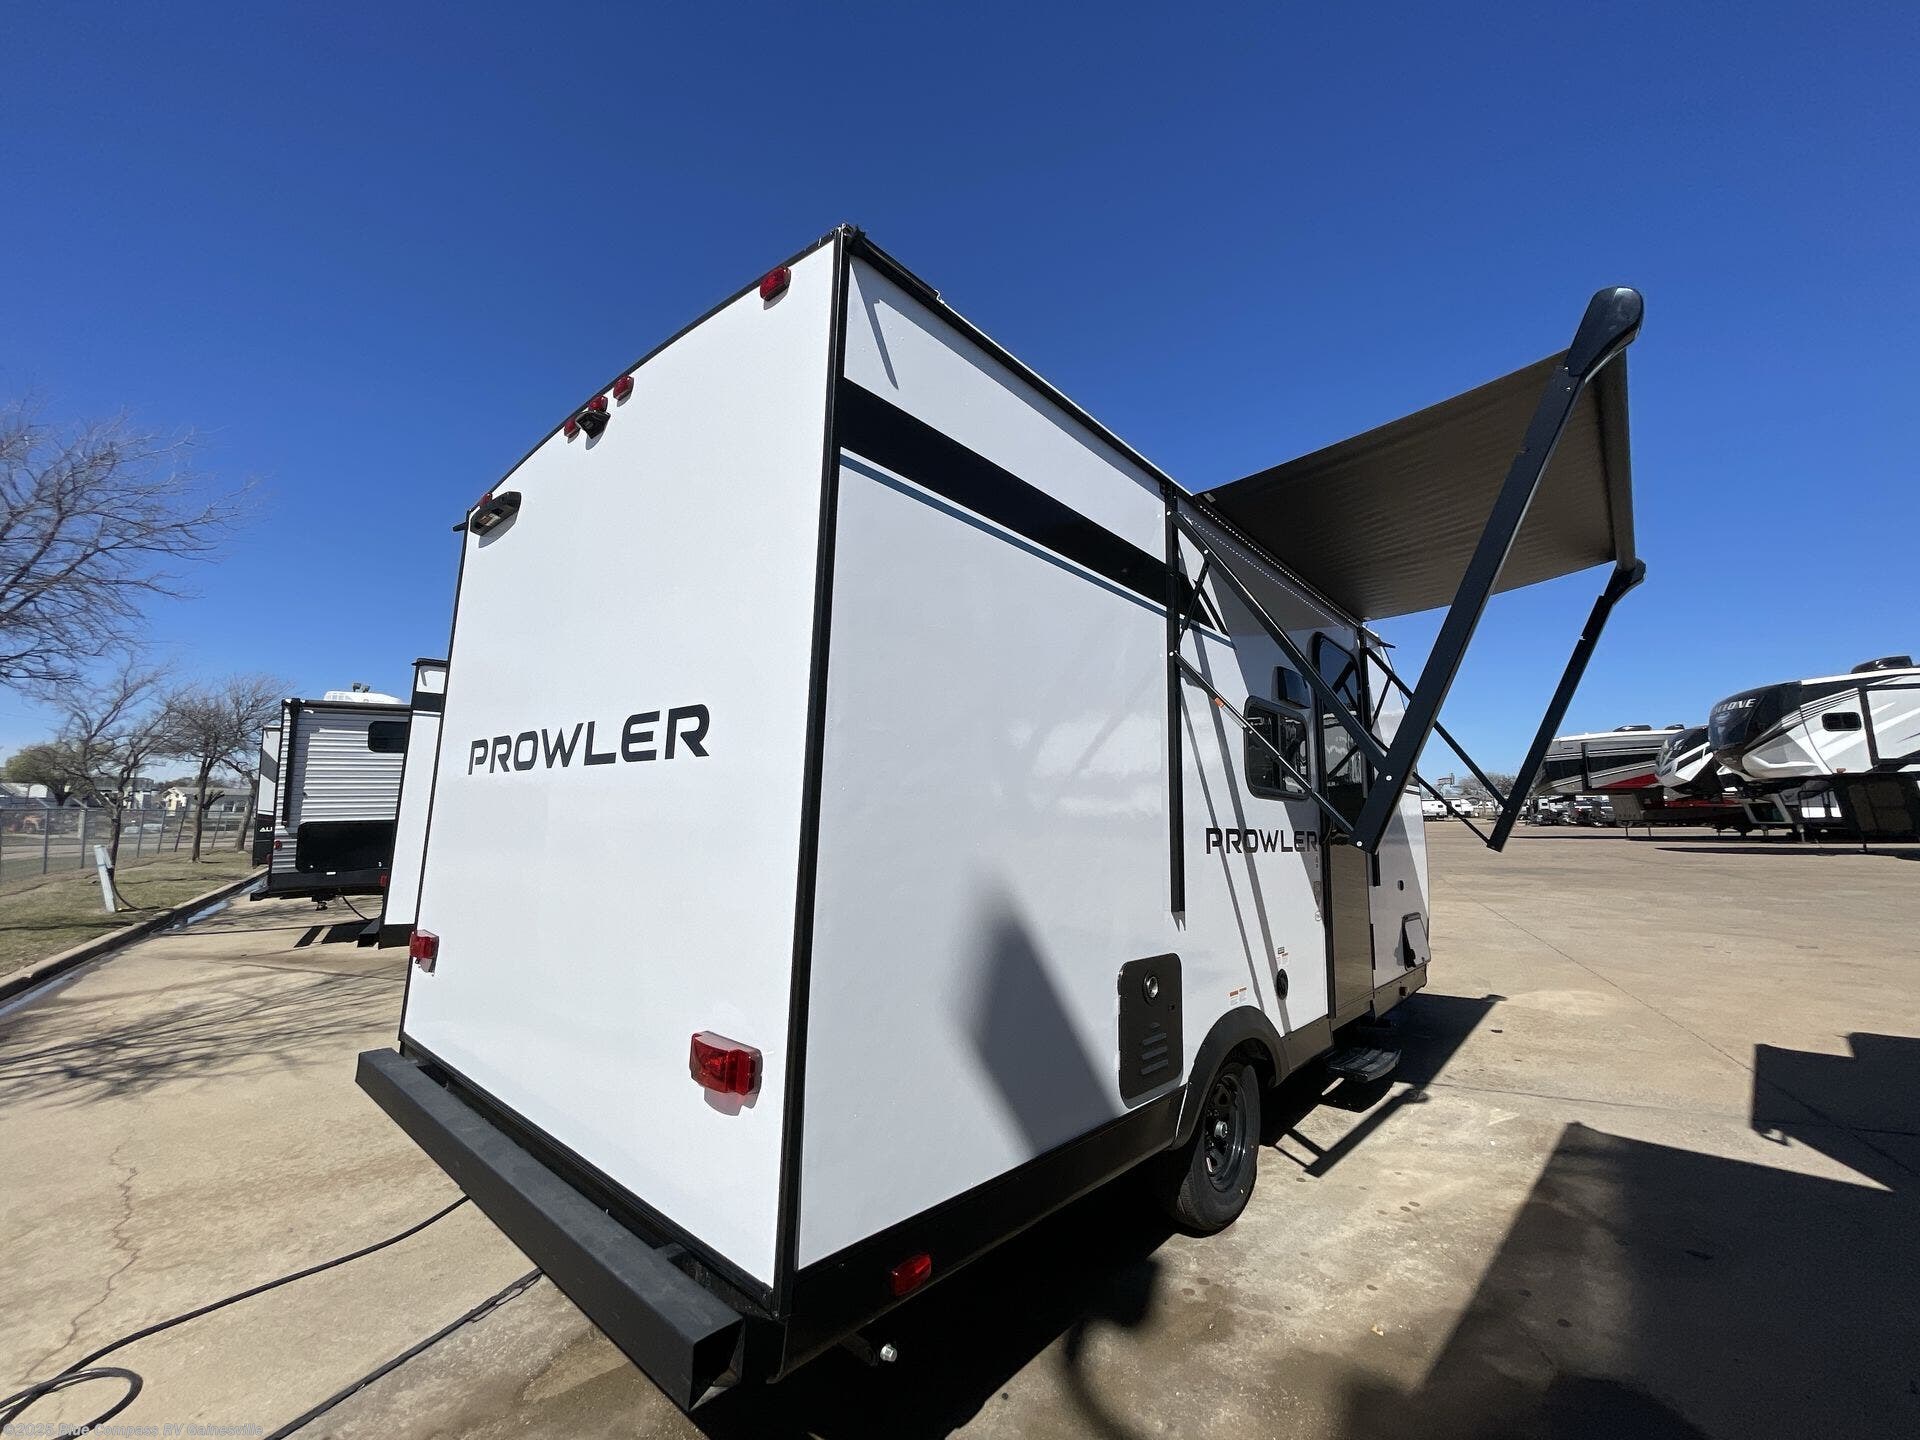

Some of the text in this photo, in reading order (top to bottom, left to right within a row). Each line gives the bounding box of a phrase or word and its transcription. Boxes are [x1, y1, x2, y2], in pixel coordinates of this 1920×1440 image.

[1713, 698, 1757, 714] CLONE
[467, 703, 711, 776] PROWLER
[1205, 827, 1319, 854] PROWLER
